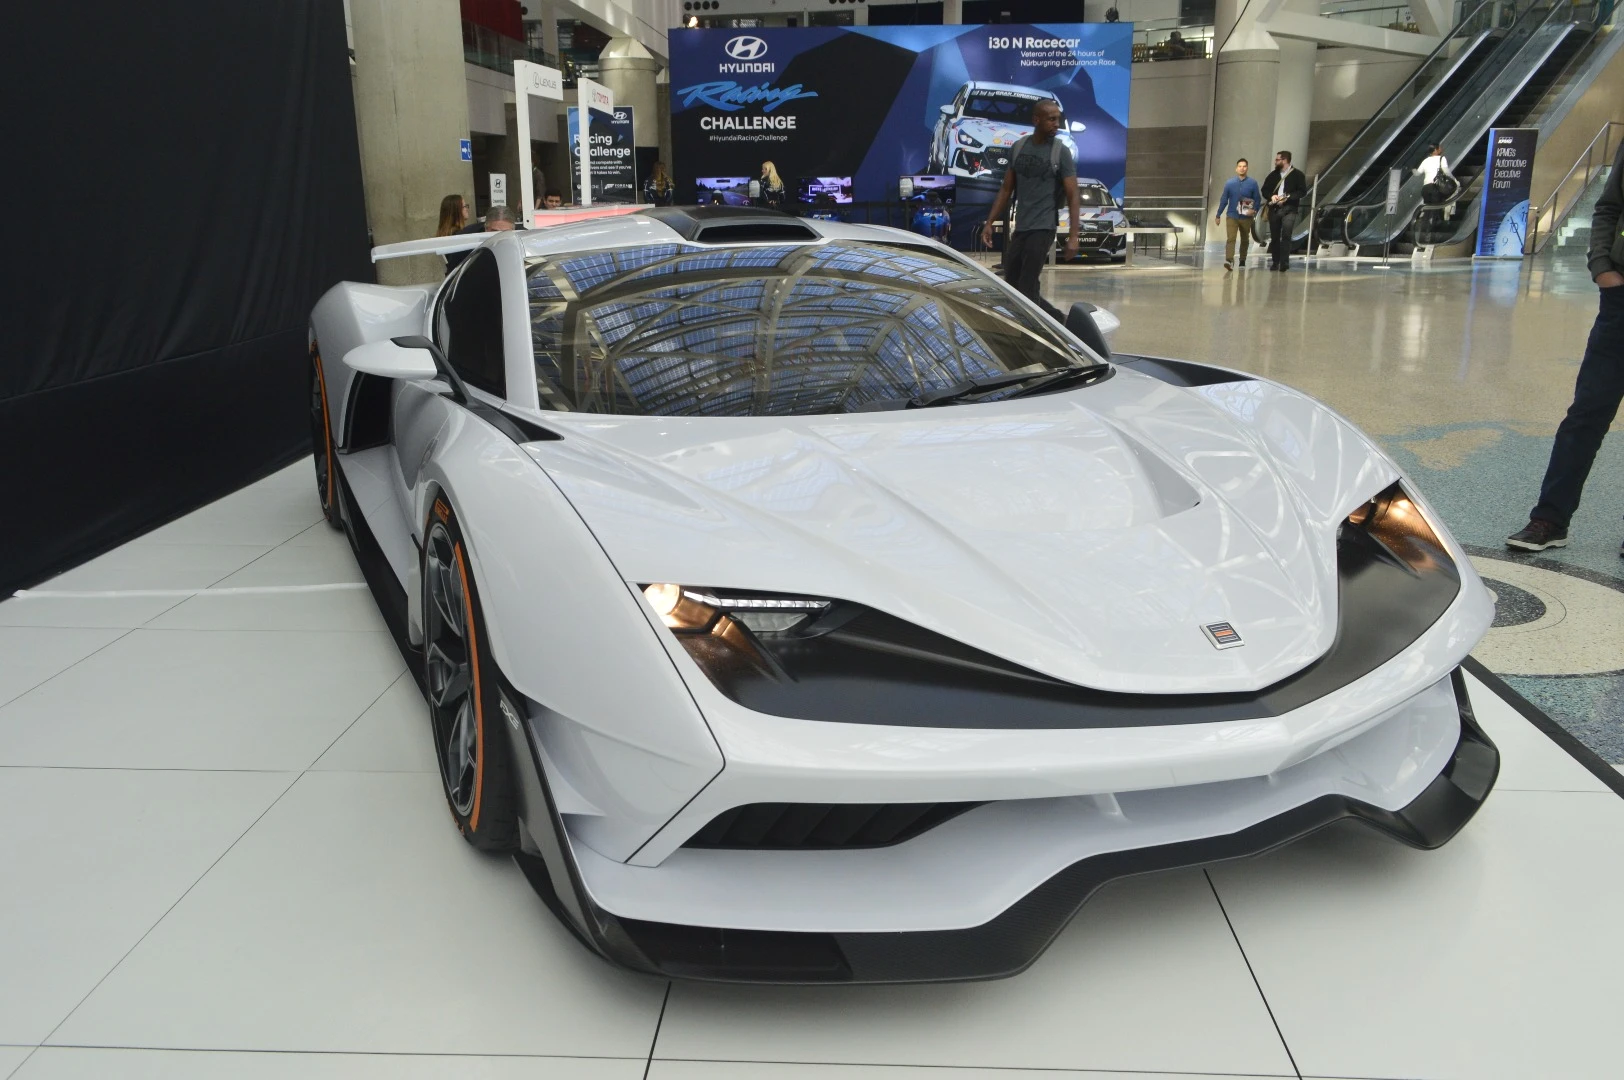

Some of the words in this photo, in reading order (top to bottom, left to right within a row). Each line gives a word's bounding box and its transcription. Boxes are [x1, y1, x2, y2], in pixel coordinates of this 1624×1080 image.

[988, 36, 1010, 49] i30
[1012, 36, 1023, 49] N
[1025, 36, 1081, 49] Racecar
[1020, 50, 1047, 58] Veteran
[719, 62, 775, 73] HYUNDAI
[1020, 59, 1061, 68] Nürburgring
[1098, 58, 1116, 66] Race
[539, 77, 557, 90] LEXUS
[676, 80, 819, 113] Racing
[700, 115, 797, 130] CHALLENGE
[573, 133, 612, 145] Rcing
[709, 133, 789, 143] #HyundaiRacingChallenge
[574, 146, 631, 158] Callenge
[1495, 158, 1527, 168] Automotive
[1493, 169, 1521, 178] Executive
[1492, 180, 1511, 189] Forum
